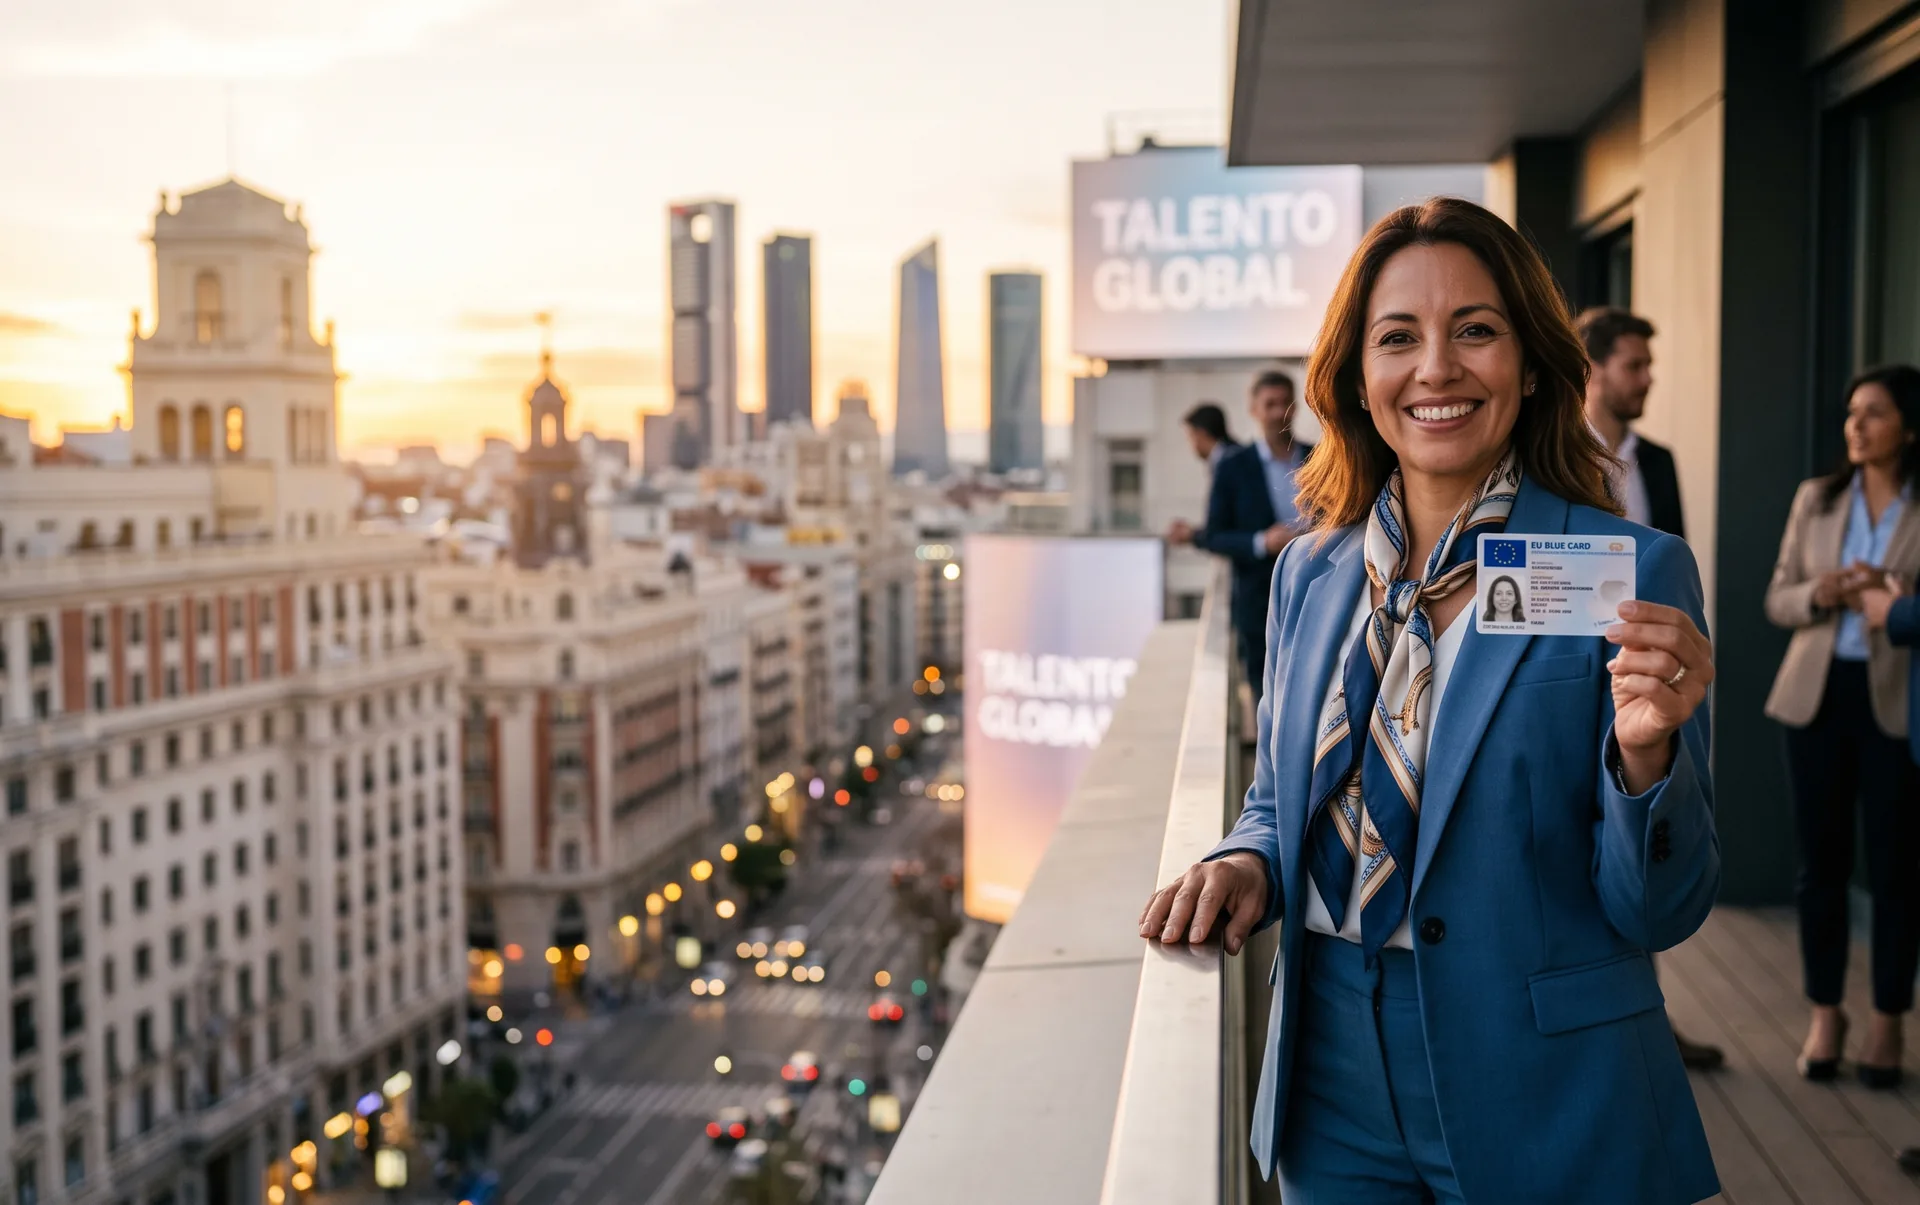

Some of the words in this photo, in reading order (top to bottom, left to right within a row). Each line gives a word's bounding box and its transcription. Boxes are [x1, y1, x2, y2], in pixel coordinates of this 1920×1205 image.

[1091, 189, 1338, 252] TALENTO
[1093, 253, 1309, 312] GLOBAL
[1531, 541, 1543, 550] EU
[1544, 541, 1566, 550] BLUE
[1567, 542, 1591, 550] CARD
